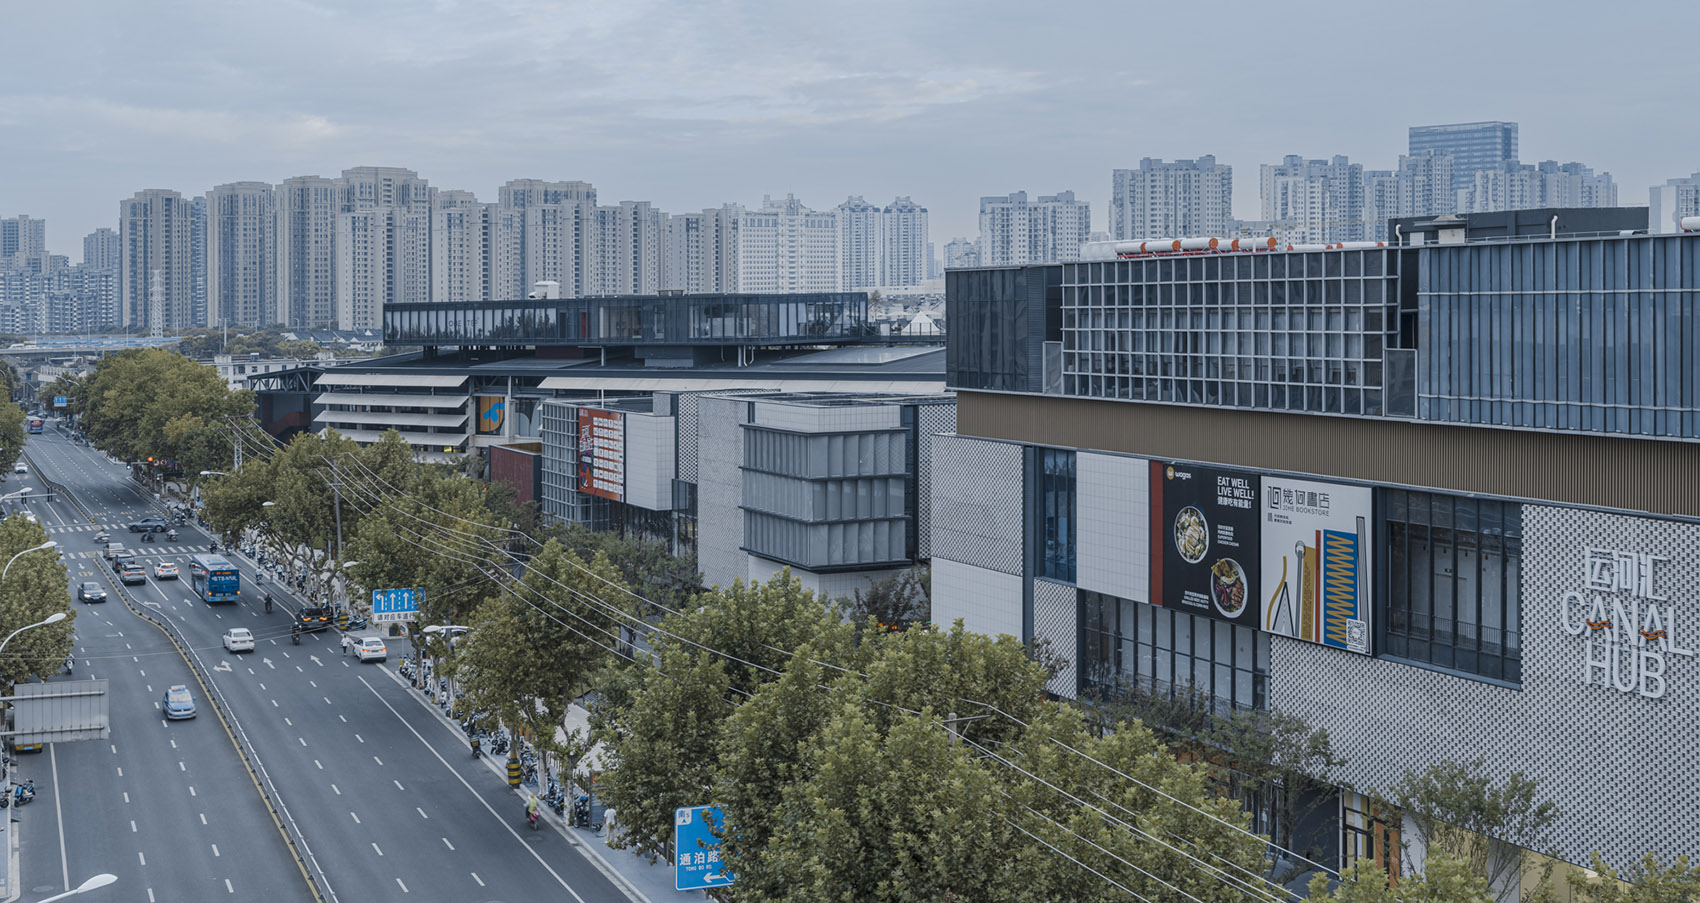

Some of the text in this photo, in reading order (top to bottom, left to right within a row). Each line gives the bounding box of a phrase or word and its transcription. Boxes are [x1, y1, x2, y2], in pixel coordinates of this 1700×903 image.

[1174, 471, 1192, 481] wagas
[1217, 476, 1250, 489] EAT WELL
[1217, 486, 1255, 500] LIVE WELL!
[1296, 507, 1330, 517] BOOKSTORE
[377, 612, 415, 621] 请对应车道行
[1562, 591, 1694, 657] CANAL
[1585, 639, 1667, 699] HUB
[677, 810, 686, 819] 南
[679, 850, 720, 866] 通泊路
